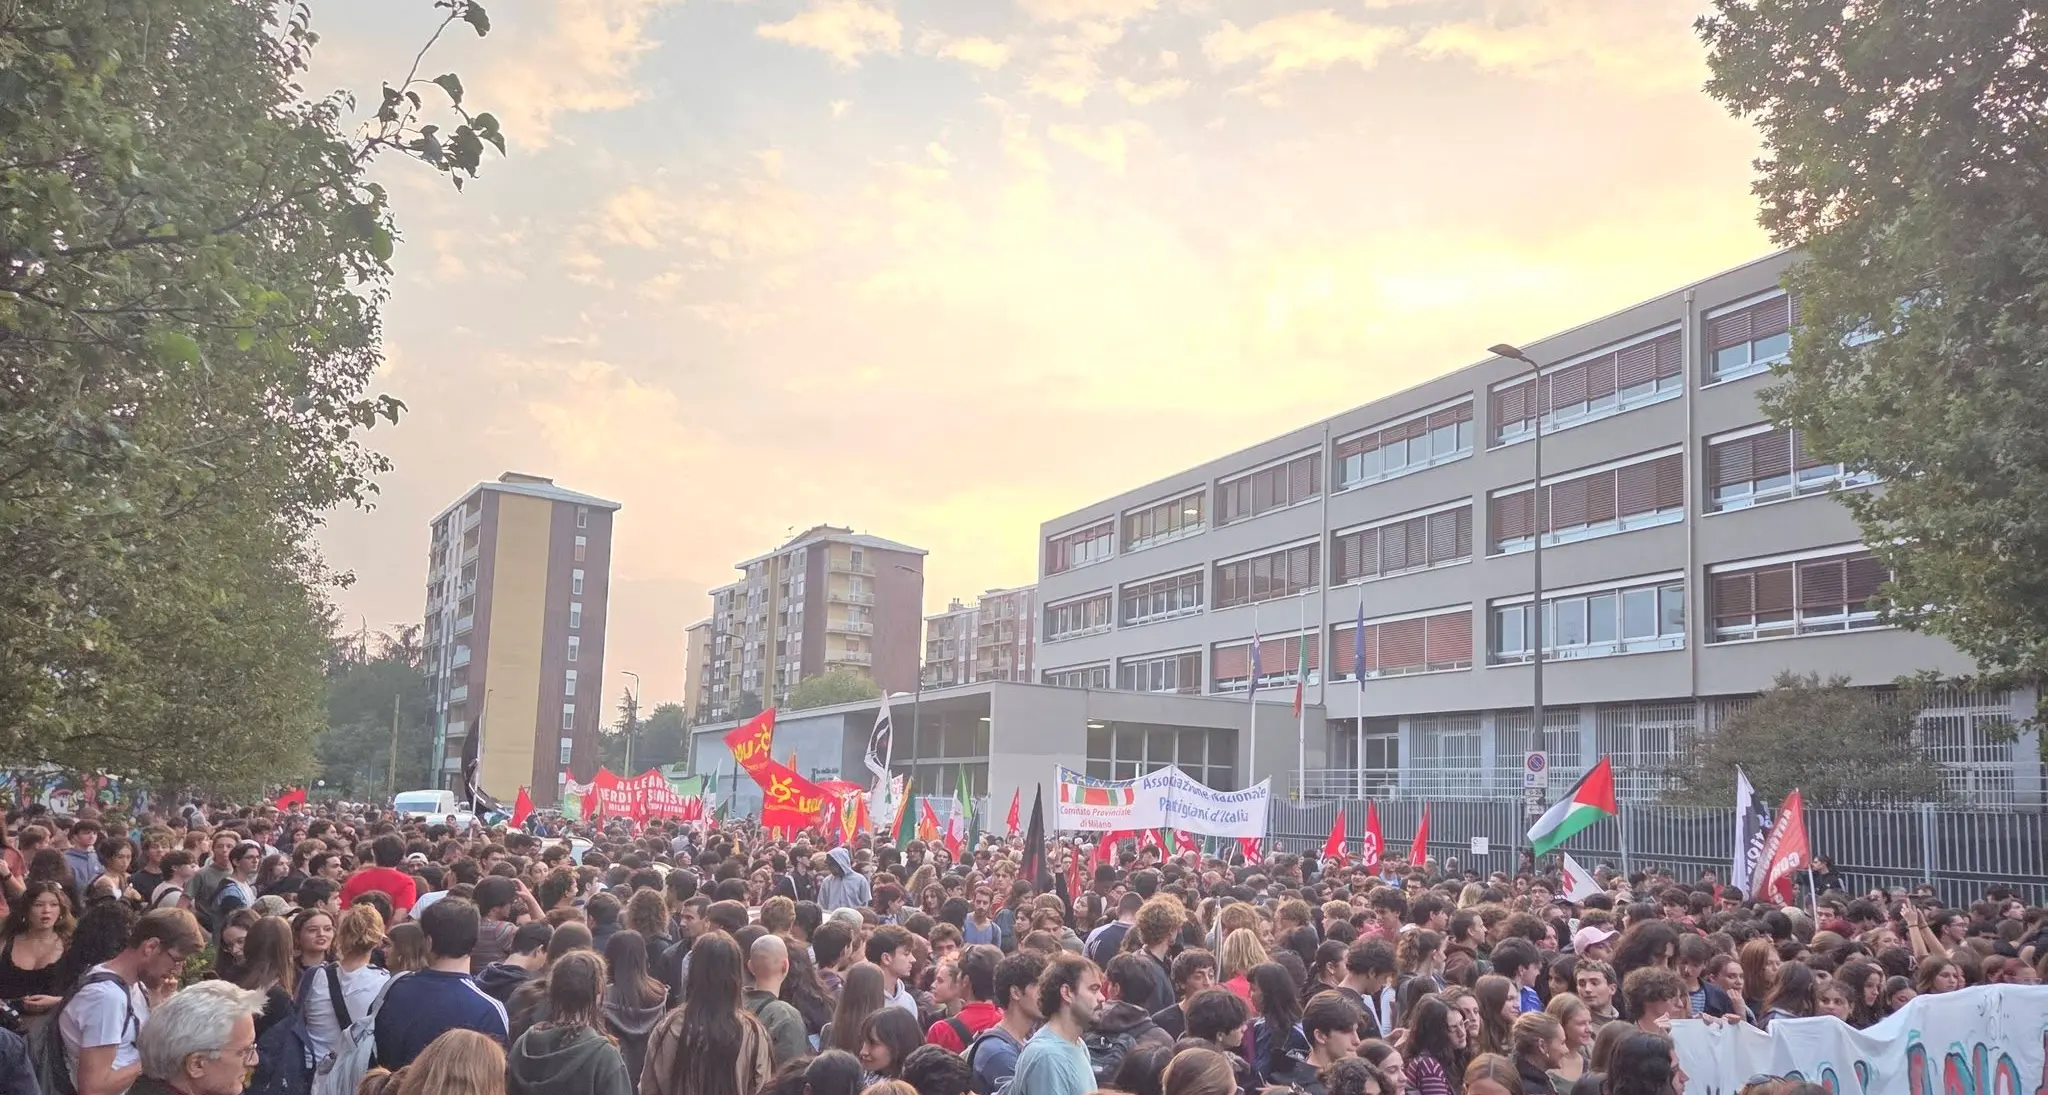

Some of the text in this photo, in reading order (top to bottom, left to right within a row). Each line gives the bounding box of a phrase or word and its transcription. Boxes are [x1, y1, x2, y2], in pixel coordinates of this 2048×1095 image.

[1092, 808, 1132, 817] Provinciale
[1080, 819, 1112, 829] di Milano
